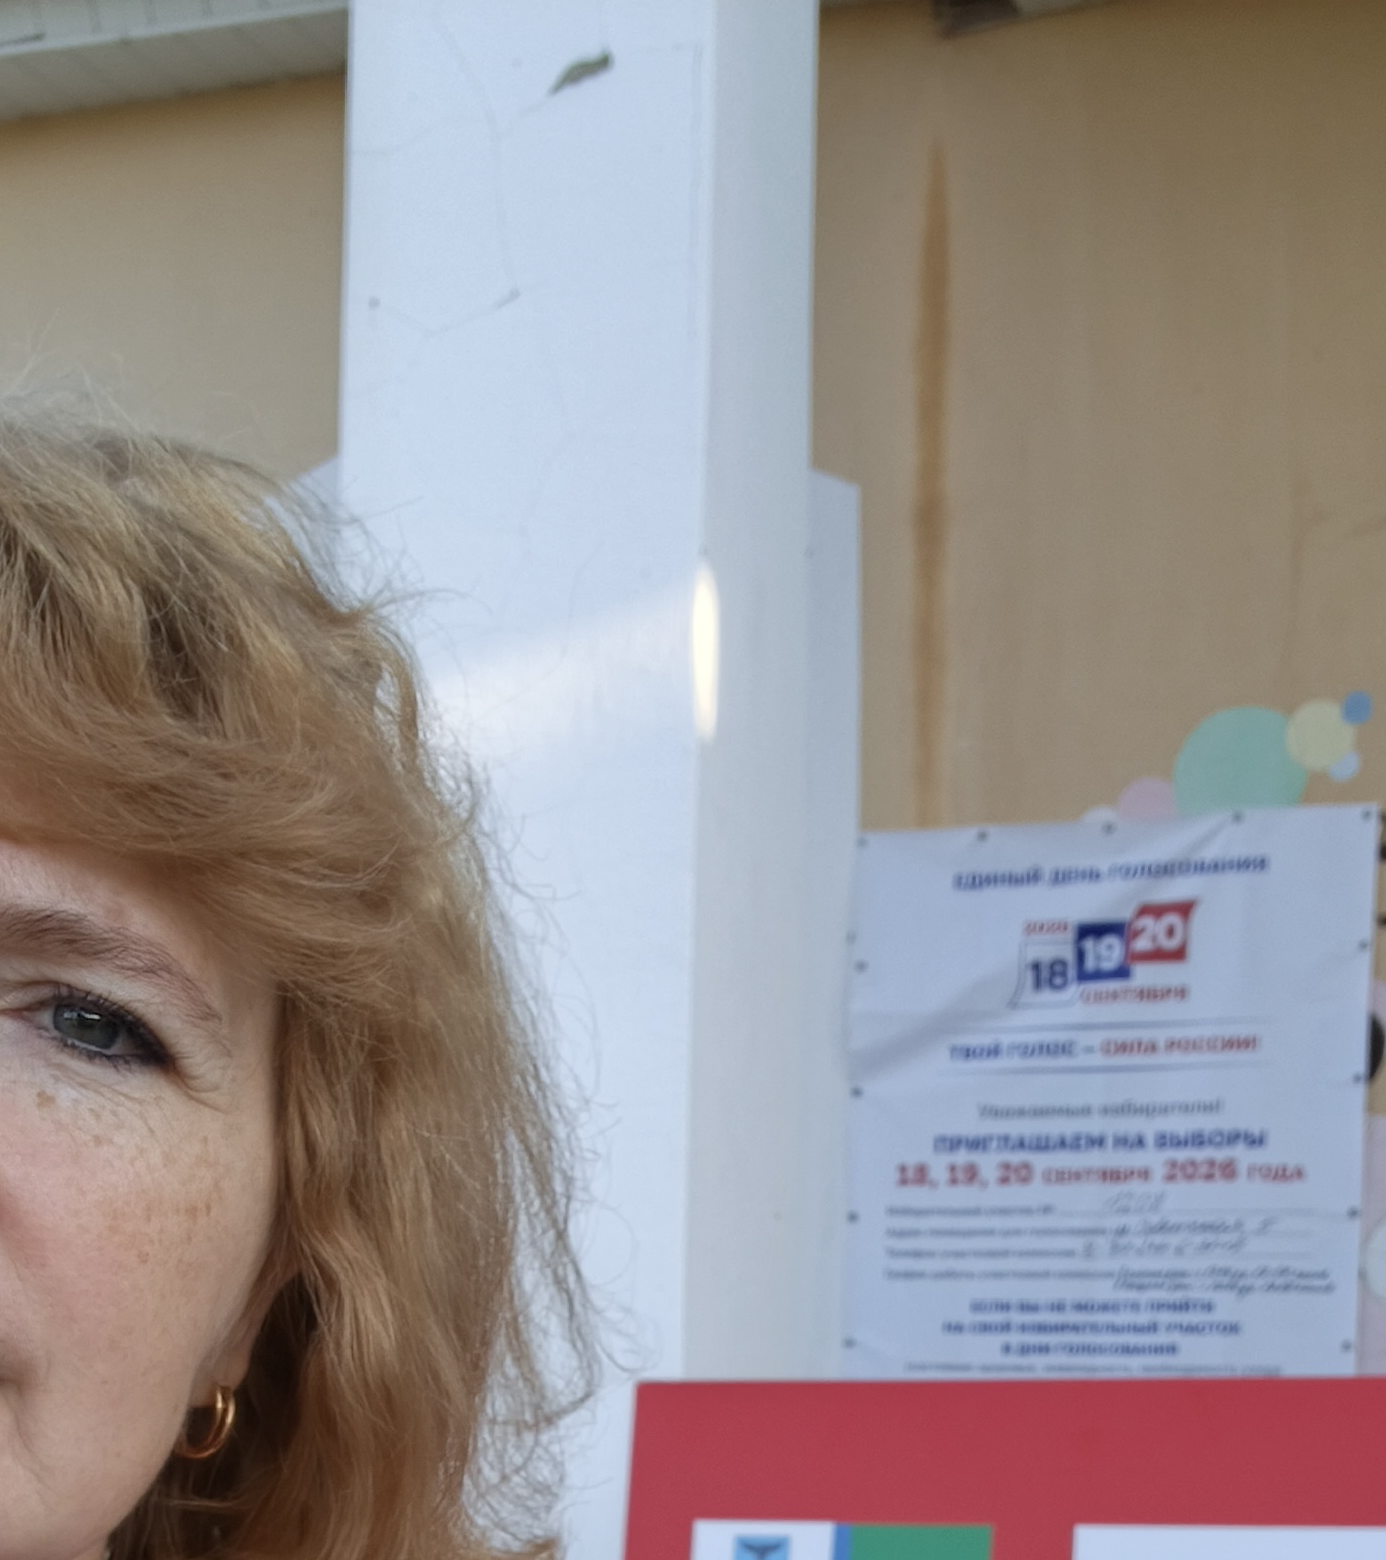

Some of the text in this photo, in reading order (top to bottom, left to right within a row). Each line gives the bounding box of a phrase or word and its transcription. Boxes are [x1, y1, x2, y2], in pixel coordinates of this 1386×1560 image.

[1131, 914, 1185, 951] 20
[1080, 935, 1122, 972] 19
[1030, 959, 1069, 991] 18
[933, 1128, 1267, 1153] ПРИГЛАШАЕМ НА ВЫБОРЫ
